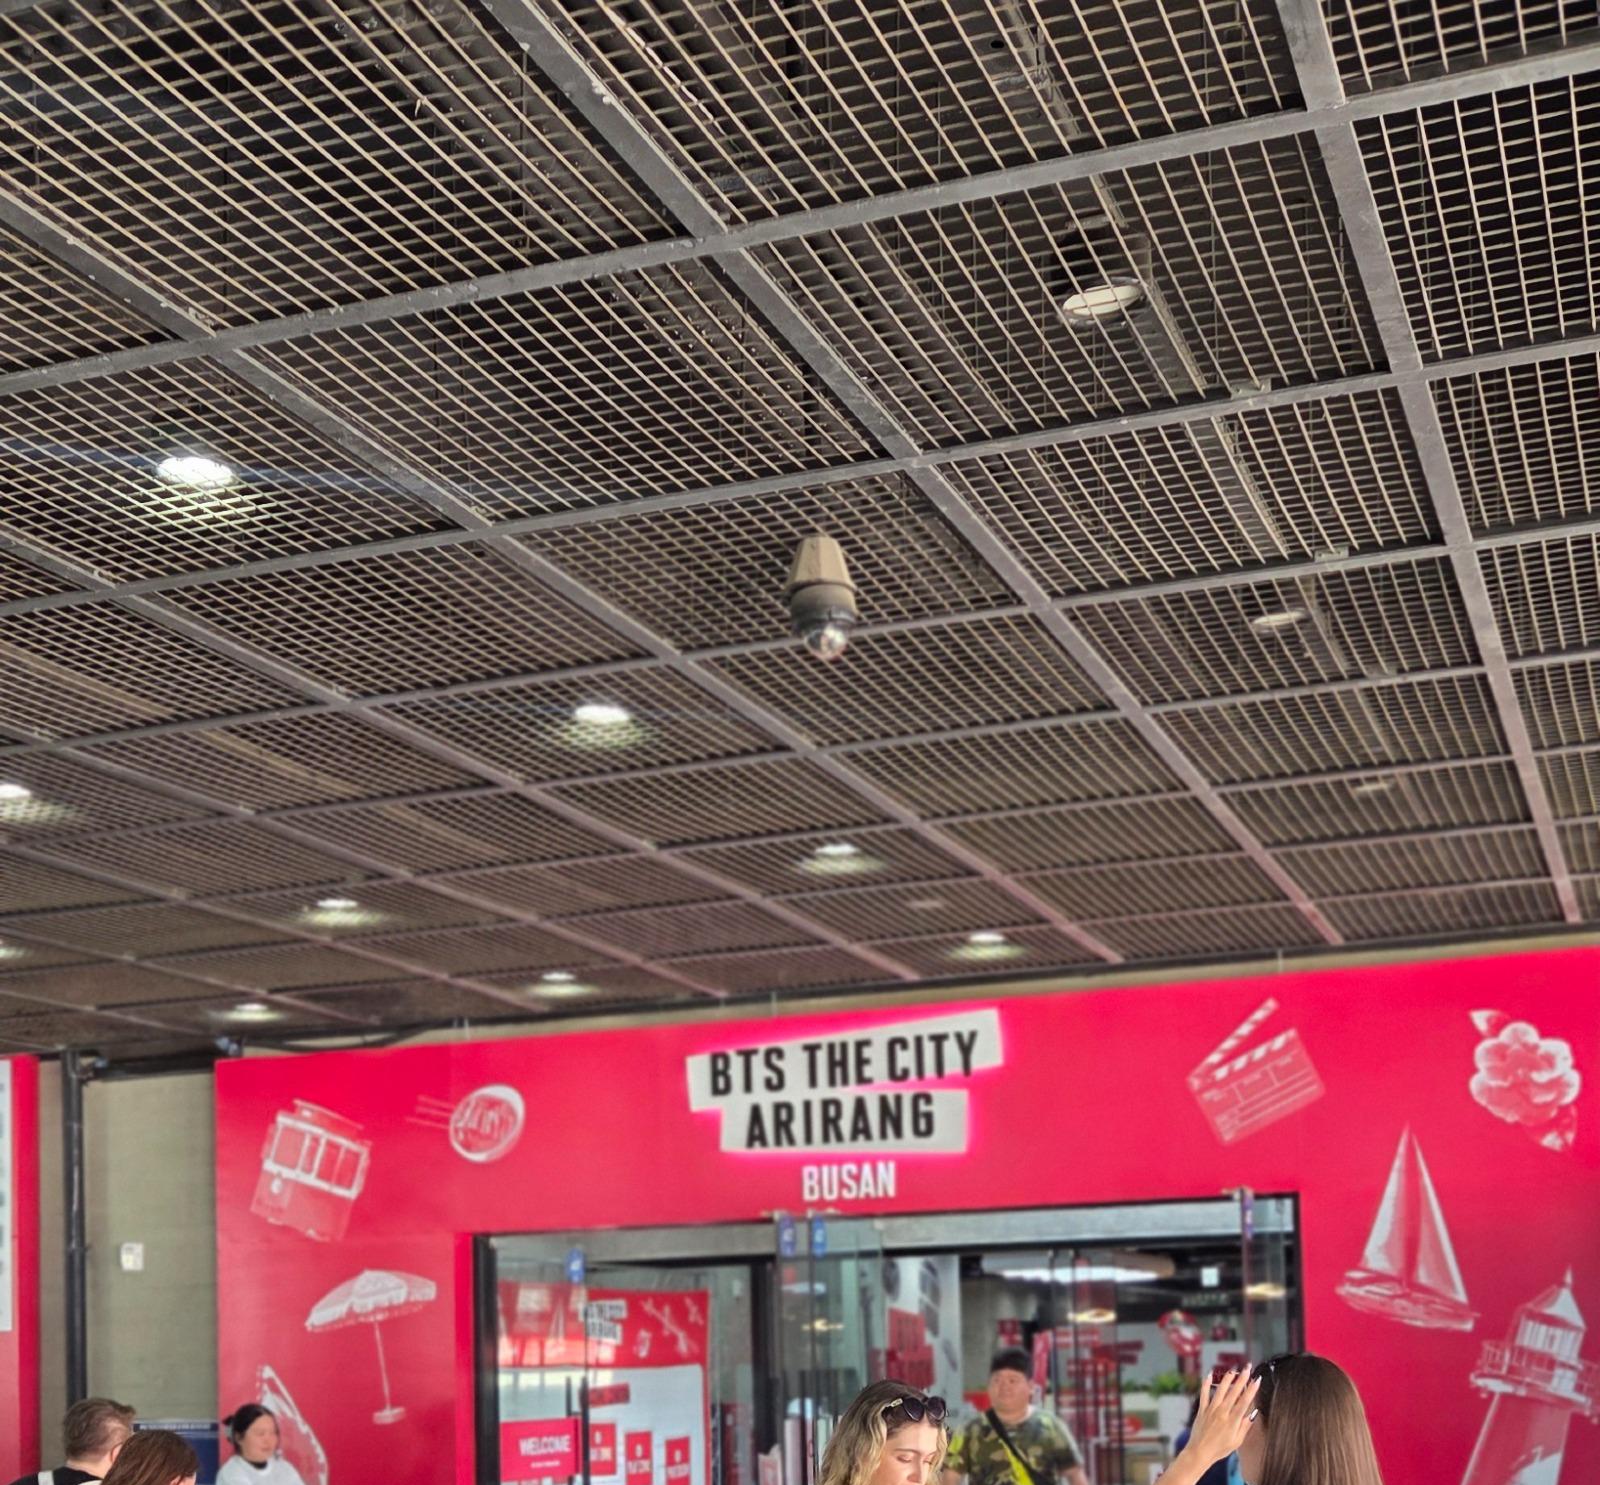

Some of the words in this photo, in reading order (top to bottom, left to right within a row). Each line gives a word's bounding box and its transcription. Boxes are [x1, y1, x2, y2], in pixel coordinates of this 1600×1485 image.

[710, 1046, 785, 1097] BTS
[802, 1038, 873, 1089] THE
[886, 1030, 978, 1083] CITY
[745, 1092, 936, 1150] ARIRANG
[802, 1161, 896, 1201] BUSAN
[519, 1435, 571, 1456] WELCOME
